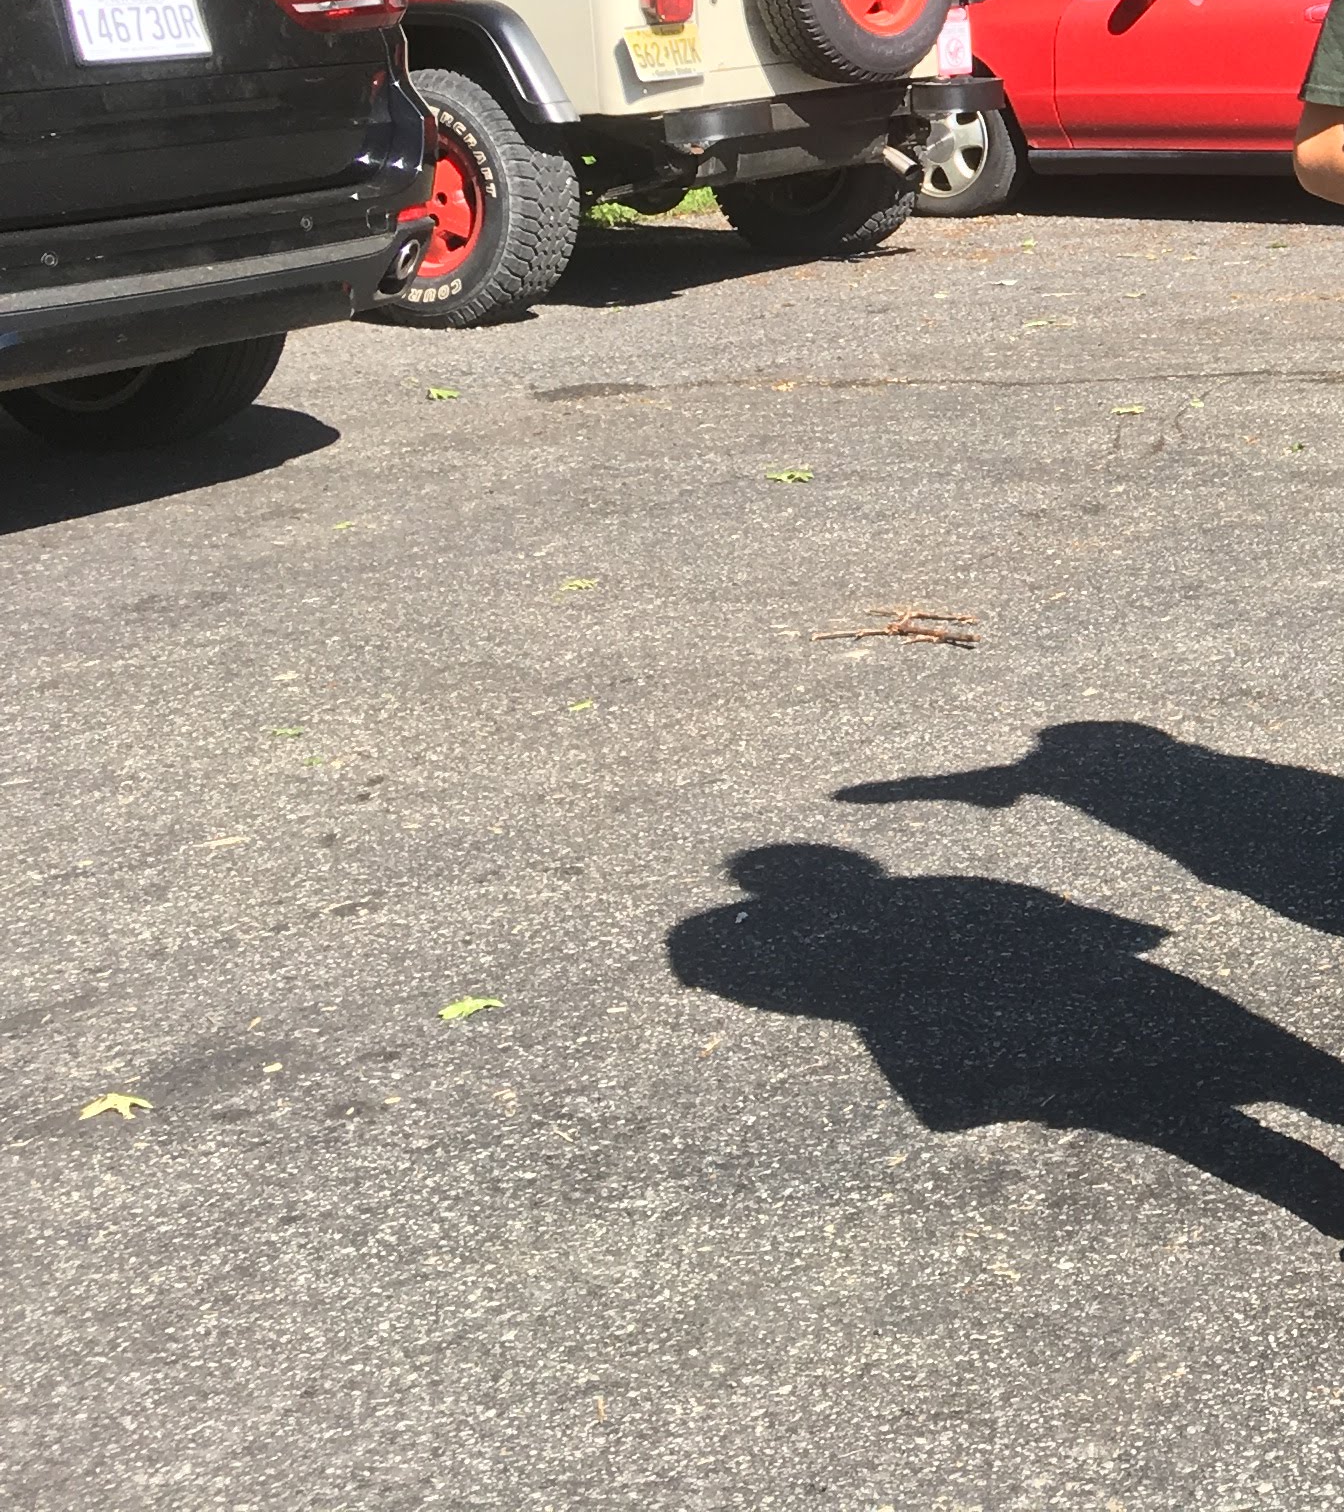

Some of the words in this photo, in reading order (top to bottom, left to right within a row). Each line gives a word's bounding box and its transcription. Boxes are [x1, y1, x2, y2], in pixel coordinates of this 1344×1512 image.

[76, 4, 201, 45] 146730R
[632, 41, 666, 69] S62
[668, 37, 703, 66] HZK
[401, 277, 463, 303] COUR
